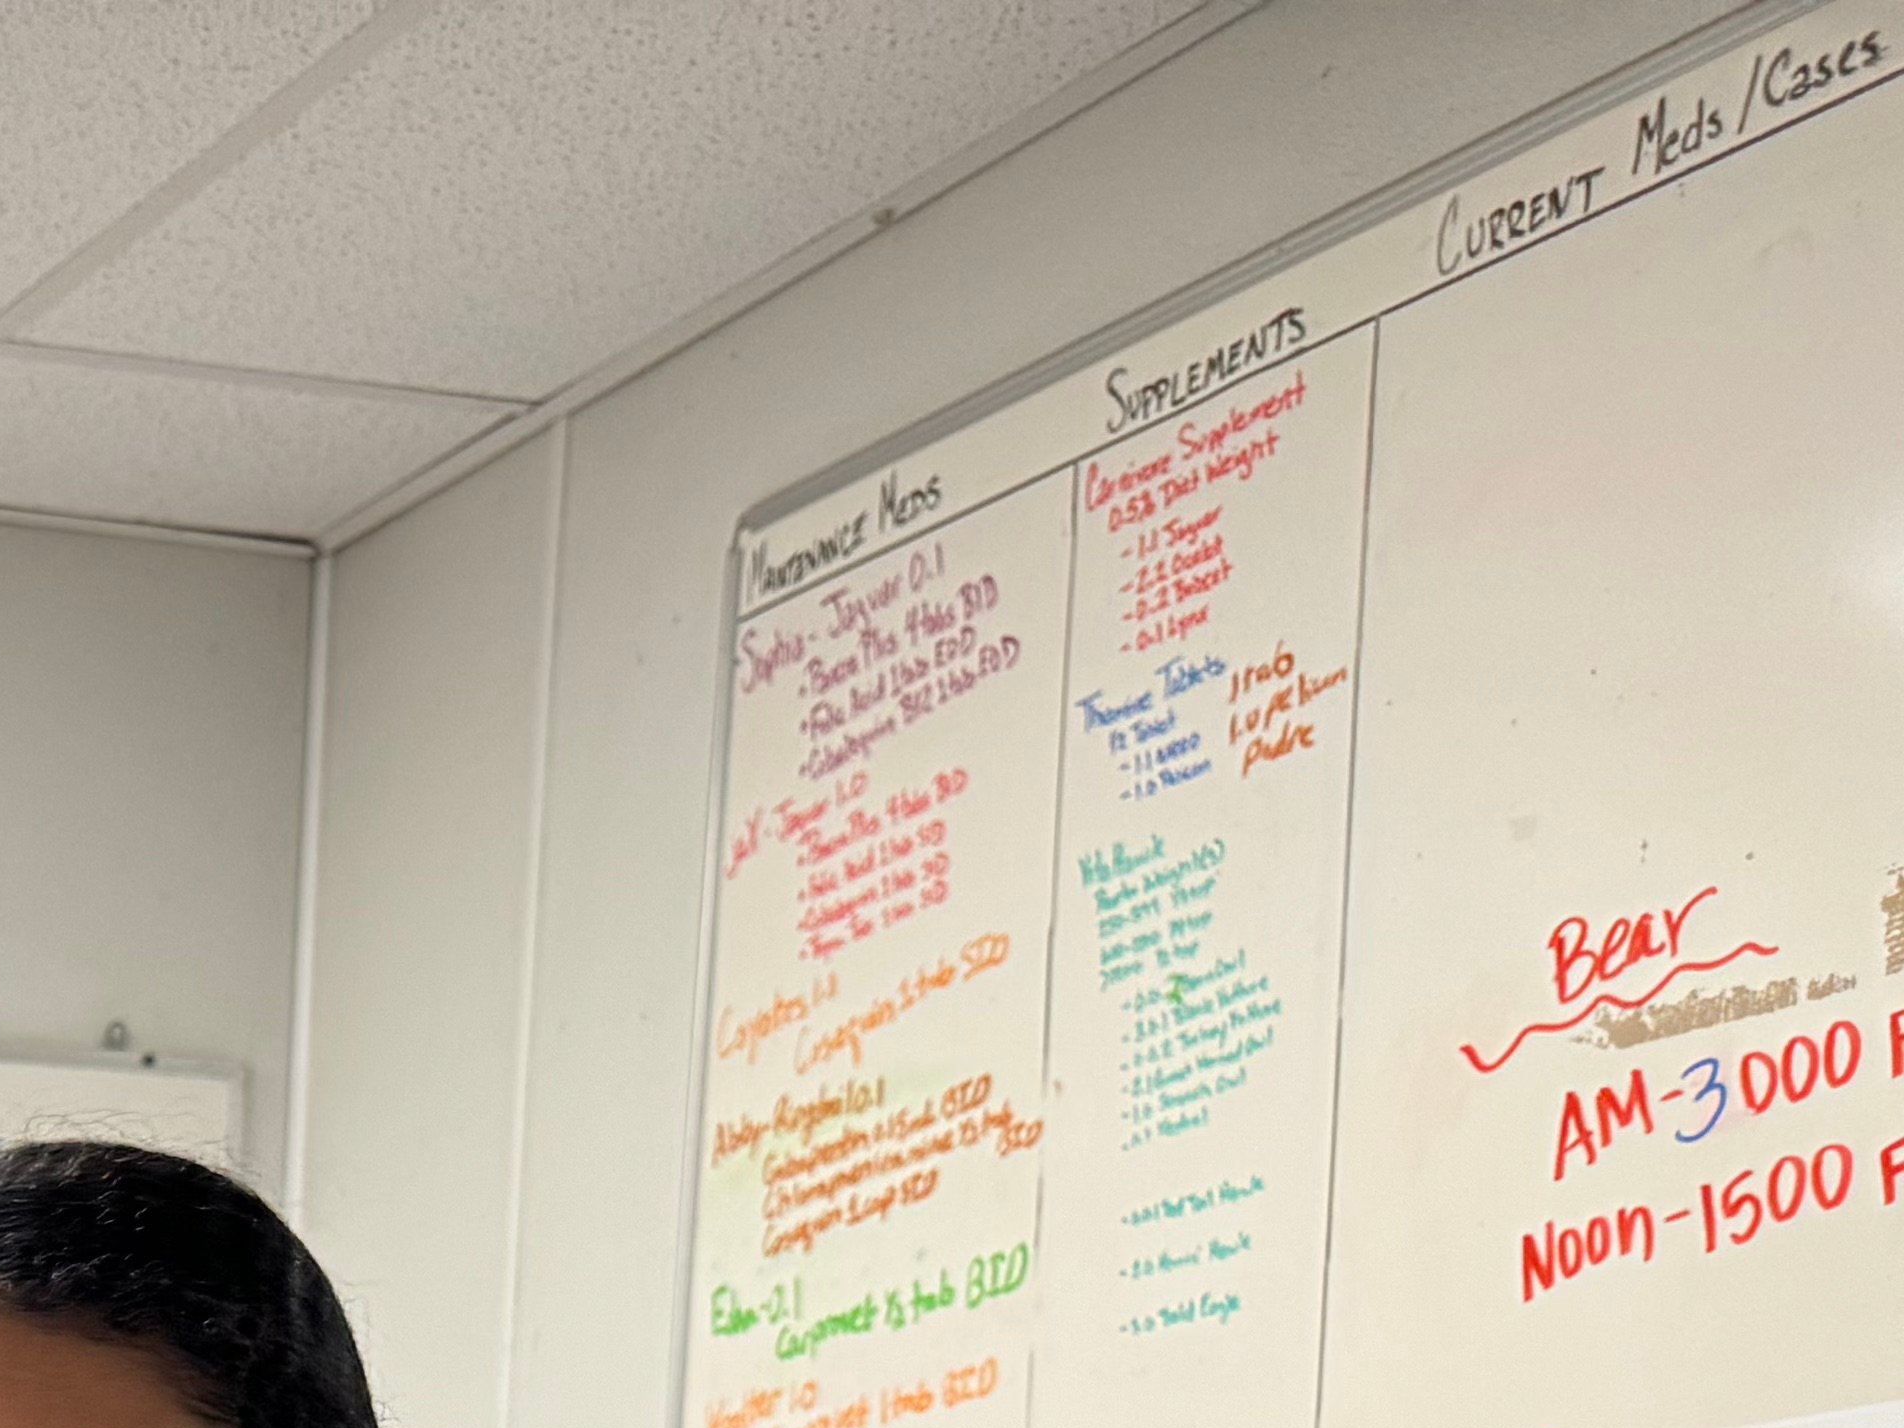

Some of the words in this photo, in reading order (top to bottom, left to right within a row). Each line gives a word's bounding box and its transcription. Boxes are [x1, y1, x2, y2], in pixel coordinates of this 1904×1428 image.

[1436, 167, 1605, 277] CURRENT
[1630, 95, 1724, 177] Meds
[1106, 305, 1307, 434] SUPPLEMENTS
[1546, 885, 1719, 1005] Bear
[965, 1239, 1030, 1312] BID
[1521, 1142, 1855, 1304] Noon-1500
